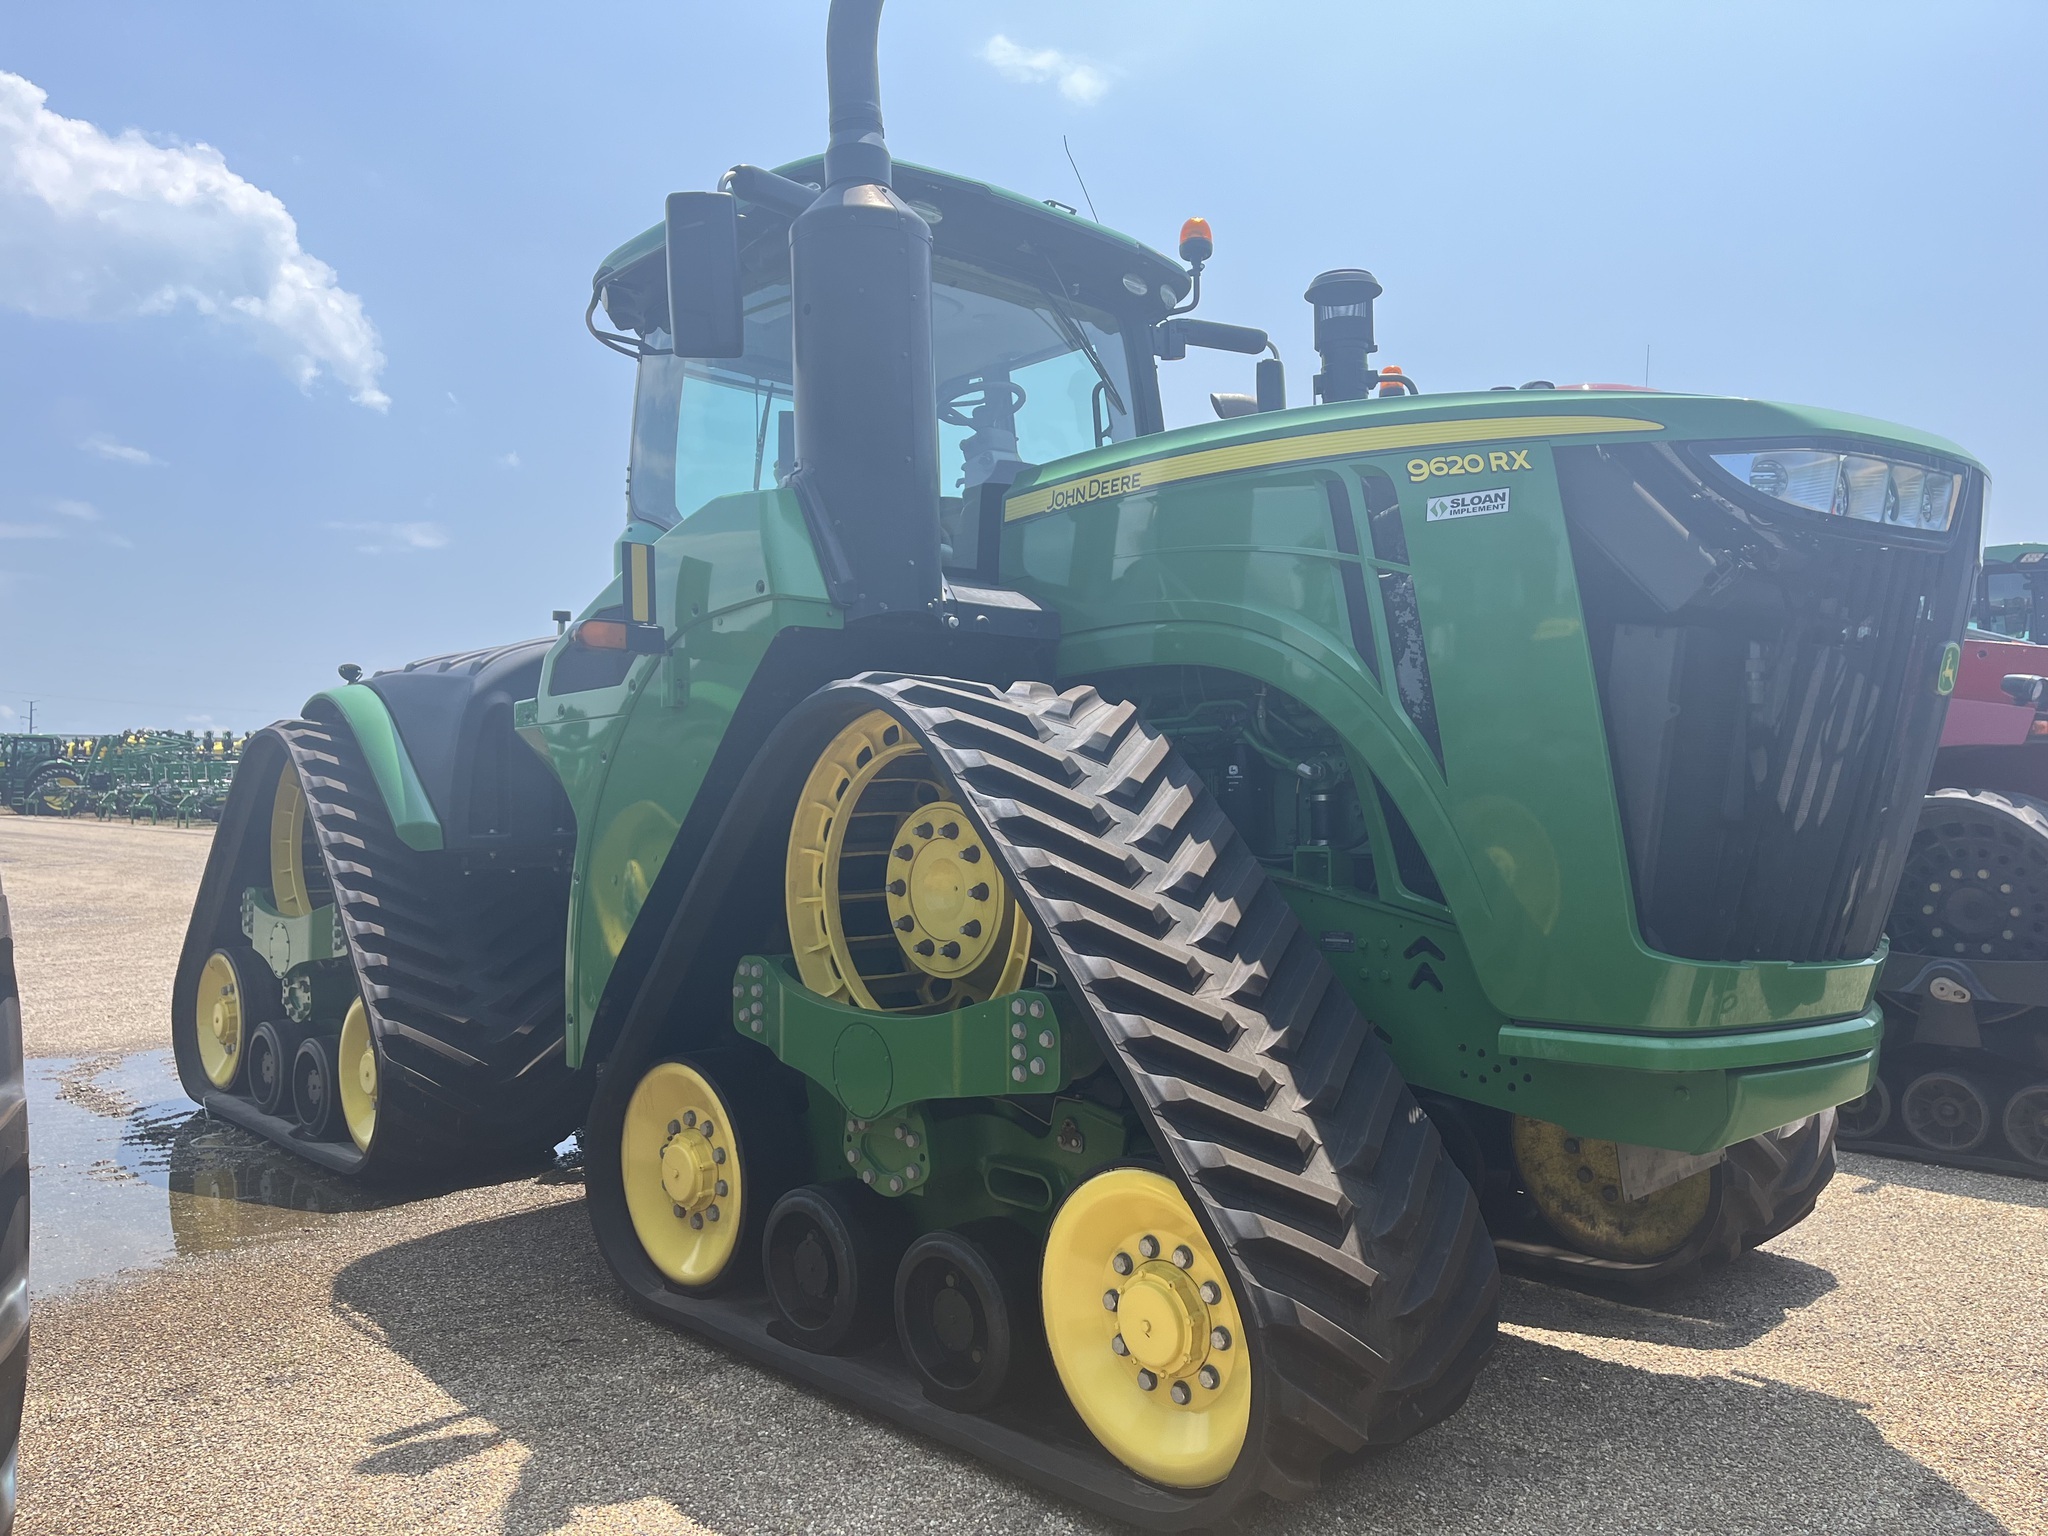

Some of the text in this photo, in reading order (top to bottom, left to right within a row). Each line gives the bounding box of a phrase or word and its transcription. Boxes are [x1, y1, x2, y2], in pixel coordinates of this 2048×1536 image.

[1407, 449, 1532, 482] 9620 RX
[1046, 473, 1142, 510] JOHN DEERE
[1450, 492, 1506, 508] SLOAN
[1450, 503, 1506, 516] IMPLEMENT
